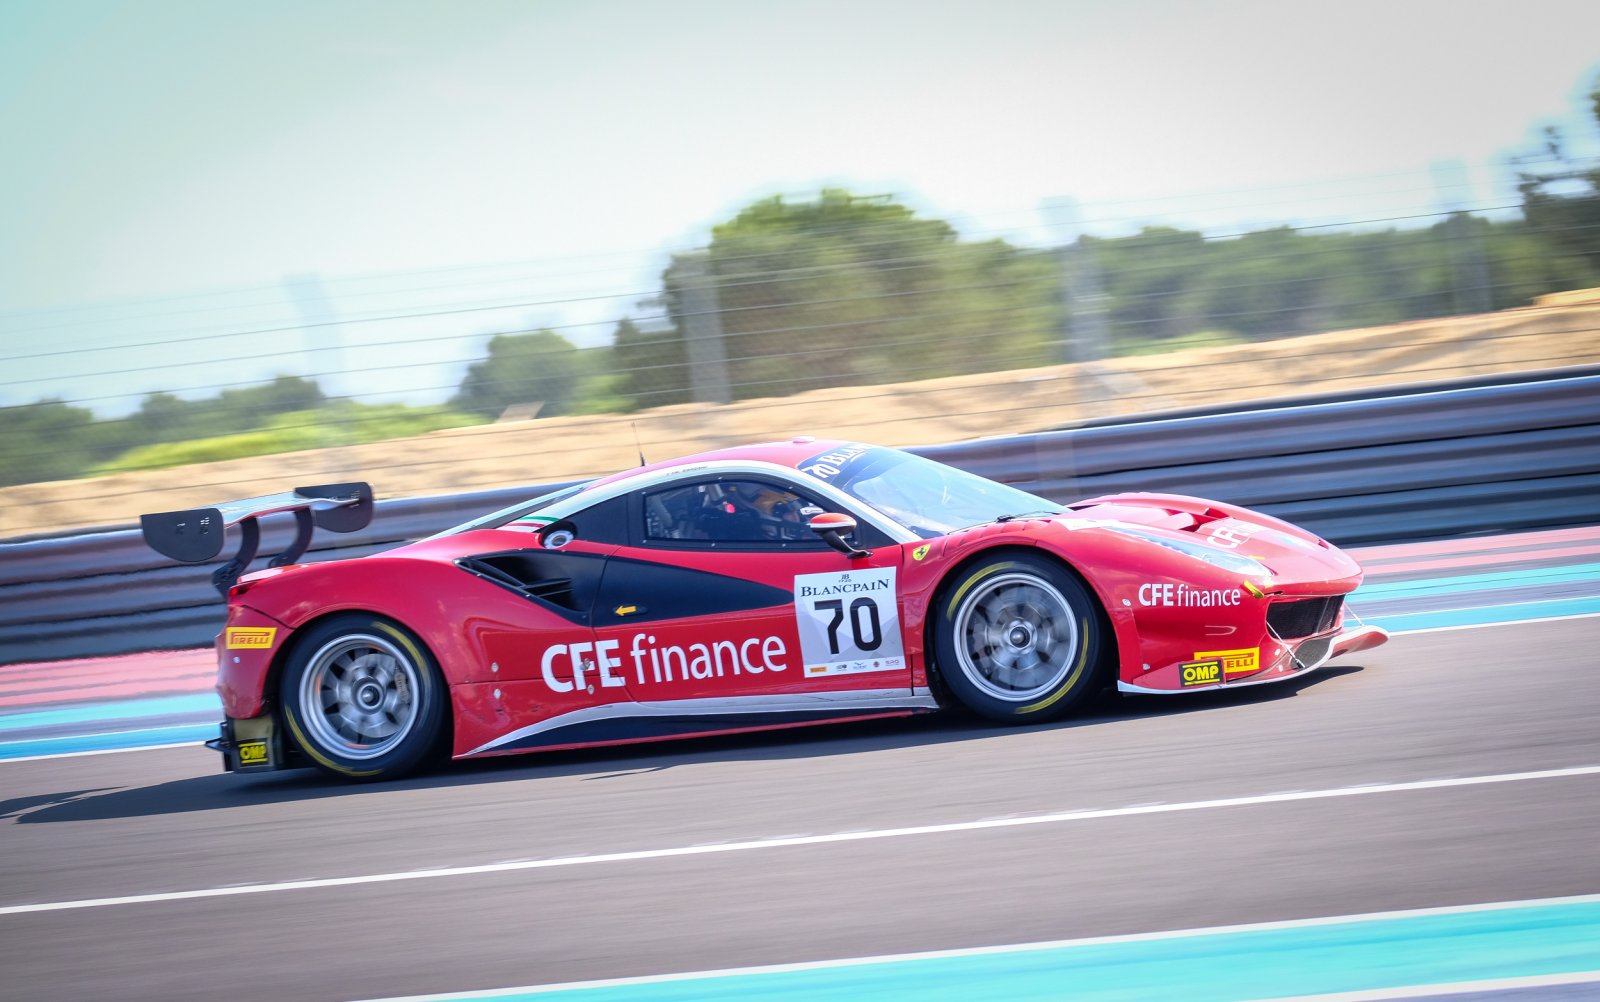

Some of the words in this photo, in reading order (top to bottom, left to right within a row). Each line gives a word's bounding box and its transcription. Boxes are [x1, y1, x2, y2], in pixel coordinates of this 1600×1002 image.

[801, 464, 840, 479] 70
[800, 578, 890, 597] BLANCPAIN
[1138, 583, 1174, 606] CFE
[1177, 583, 1241, 607] finance
[814, 597, 882, 655] 70
[230, 631, 271, 645] PIRELLI
[540, 639, 626, 693] CFE
[630, 633, 788, 685] finance
[1183, 665, 1219, 681] OMP
[240, 744, 267, 759] OMP
